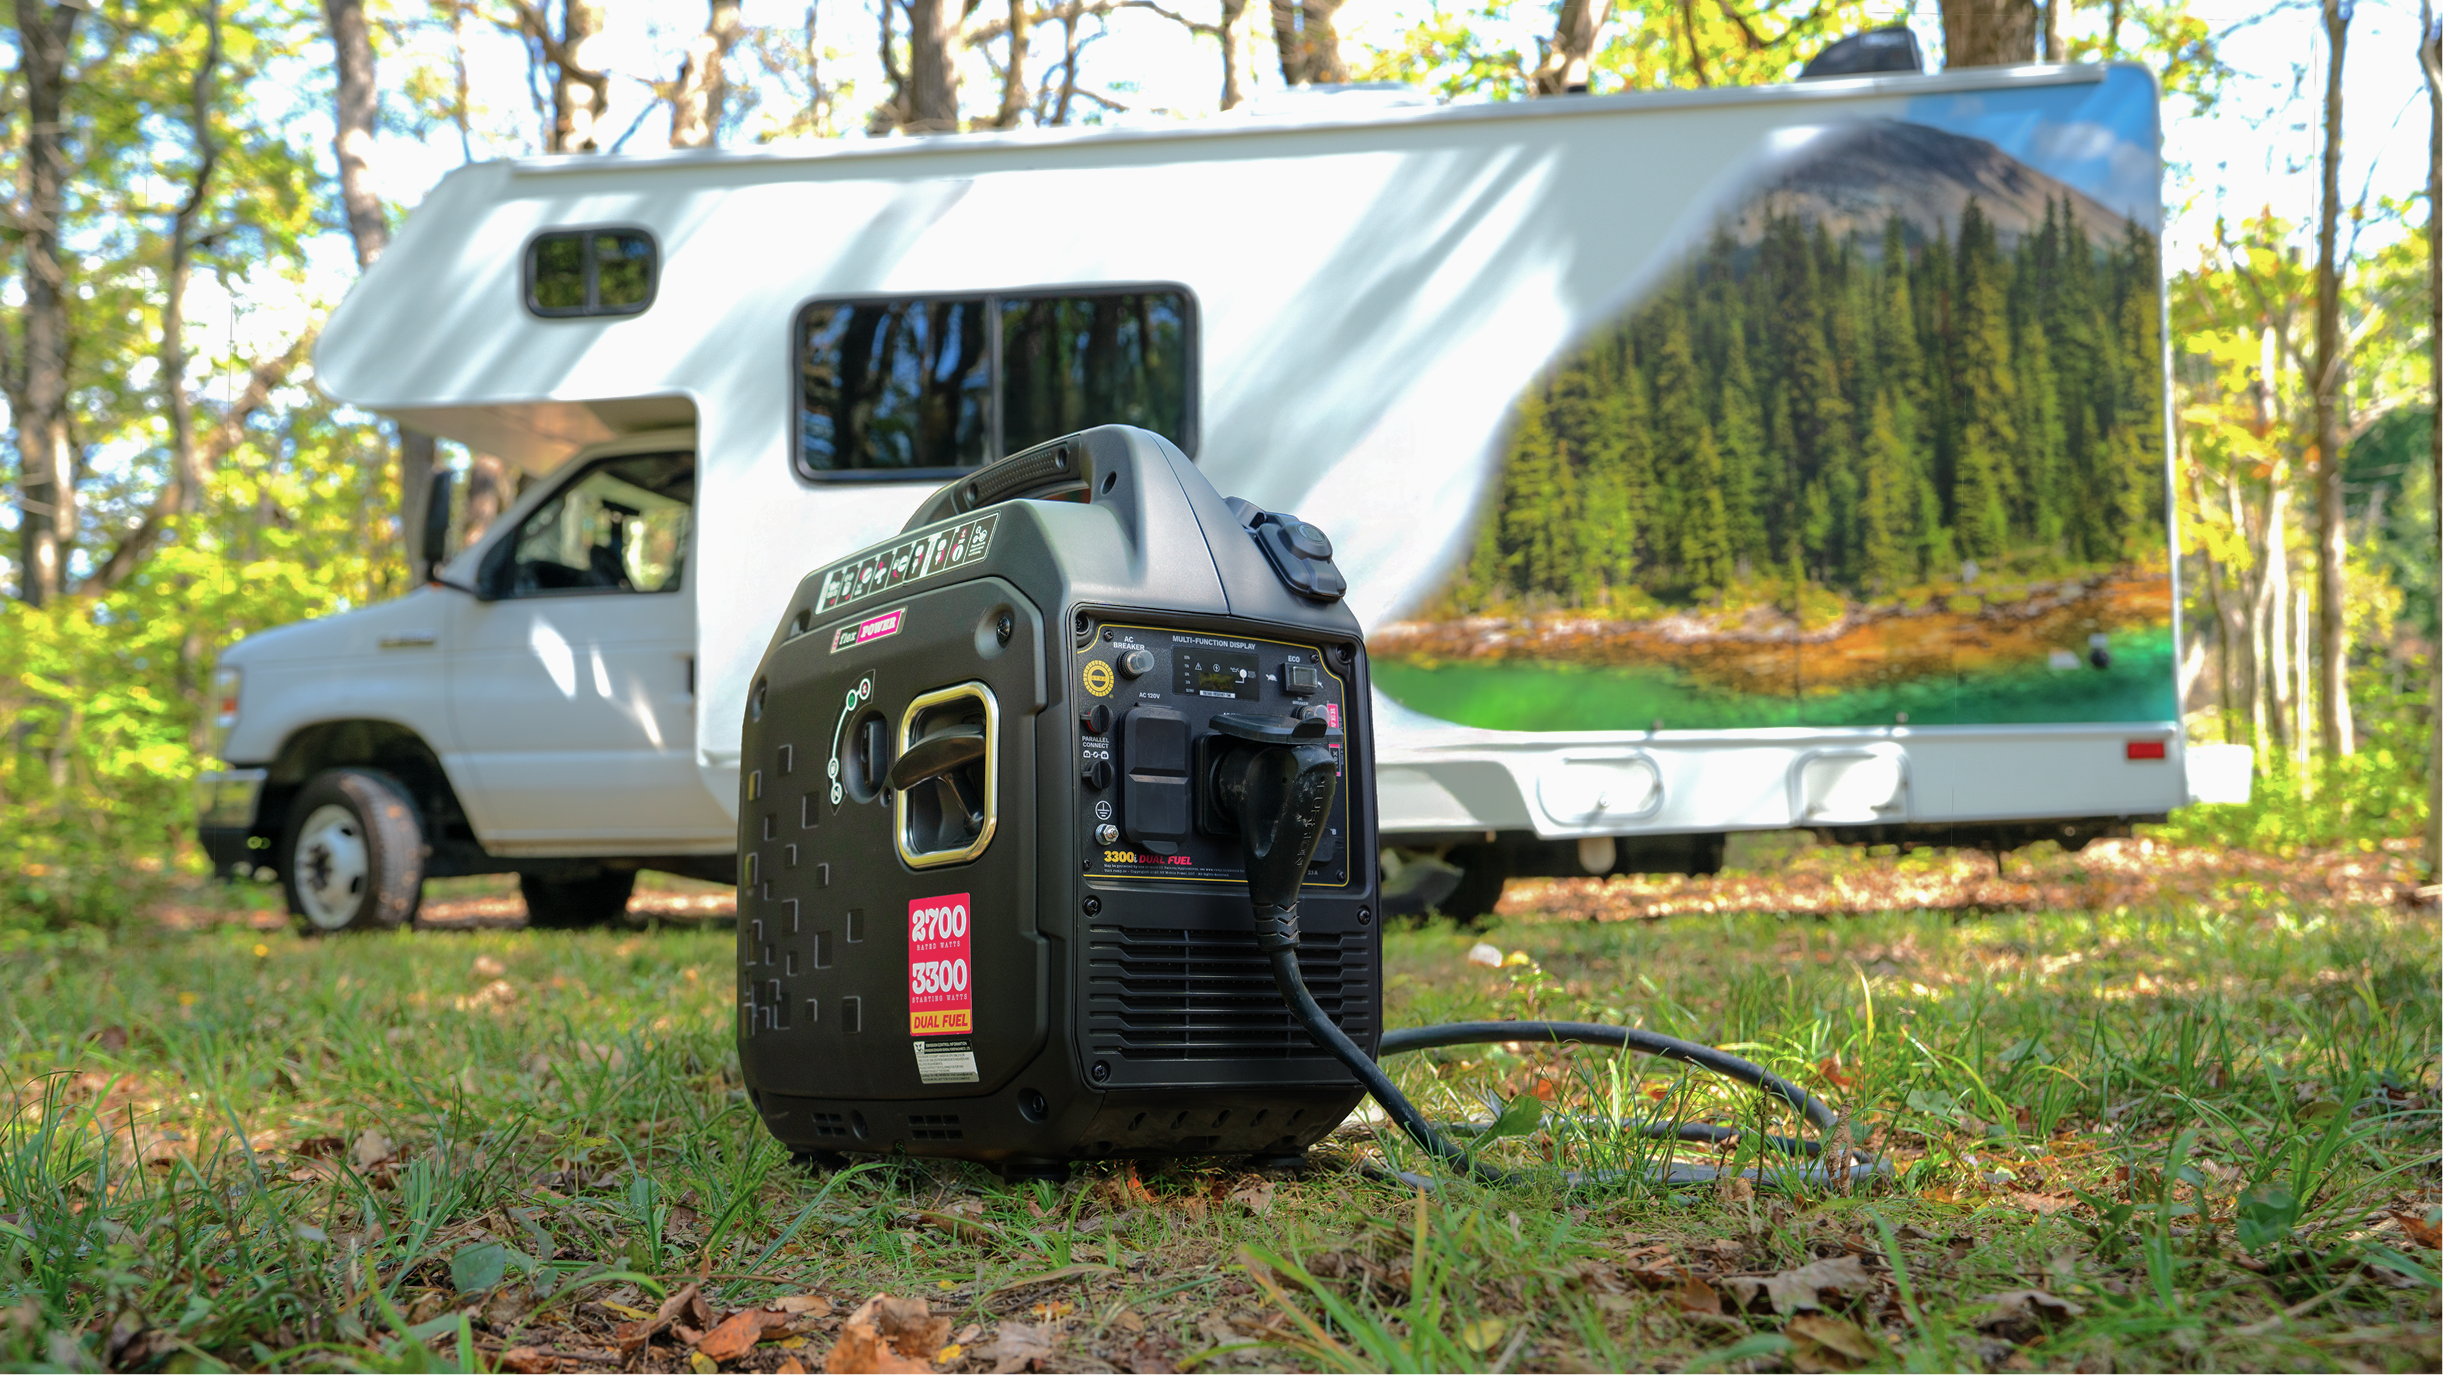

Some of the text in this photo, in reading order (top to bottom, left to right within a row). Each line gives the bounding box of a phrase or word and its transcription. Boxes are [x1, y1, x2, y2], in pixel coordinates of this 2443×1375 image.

[839, 631, 857, 645] flex
[860, 616, 897, 638] POWER
[1113, 641, 1145, 651] BREAKER
[1172, 635, 1256, 650] MULTI-FUNCTION DISPLAY
[1287, 655, 1301, 663] ECO
[1082, 735, 1110, 743] PARALLEL
[1139, 855, 1165, 864] DUAL
[1167, 855, 1193, 866] FUEL
[912, 904, 967, 942] 2700
[916, 940, 961, 951] RATED WATTS
[912, 958, 968, 994] 3300
[912, 993, 968, 1003] STARTING WATTS
[914, 1013, 968, 1029] DUAL FUEL
